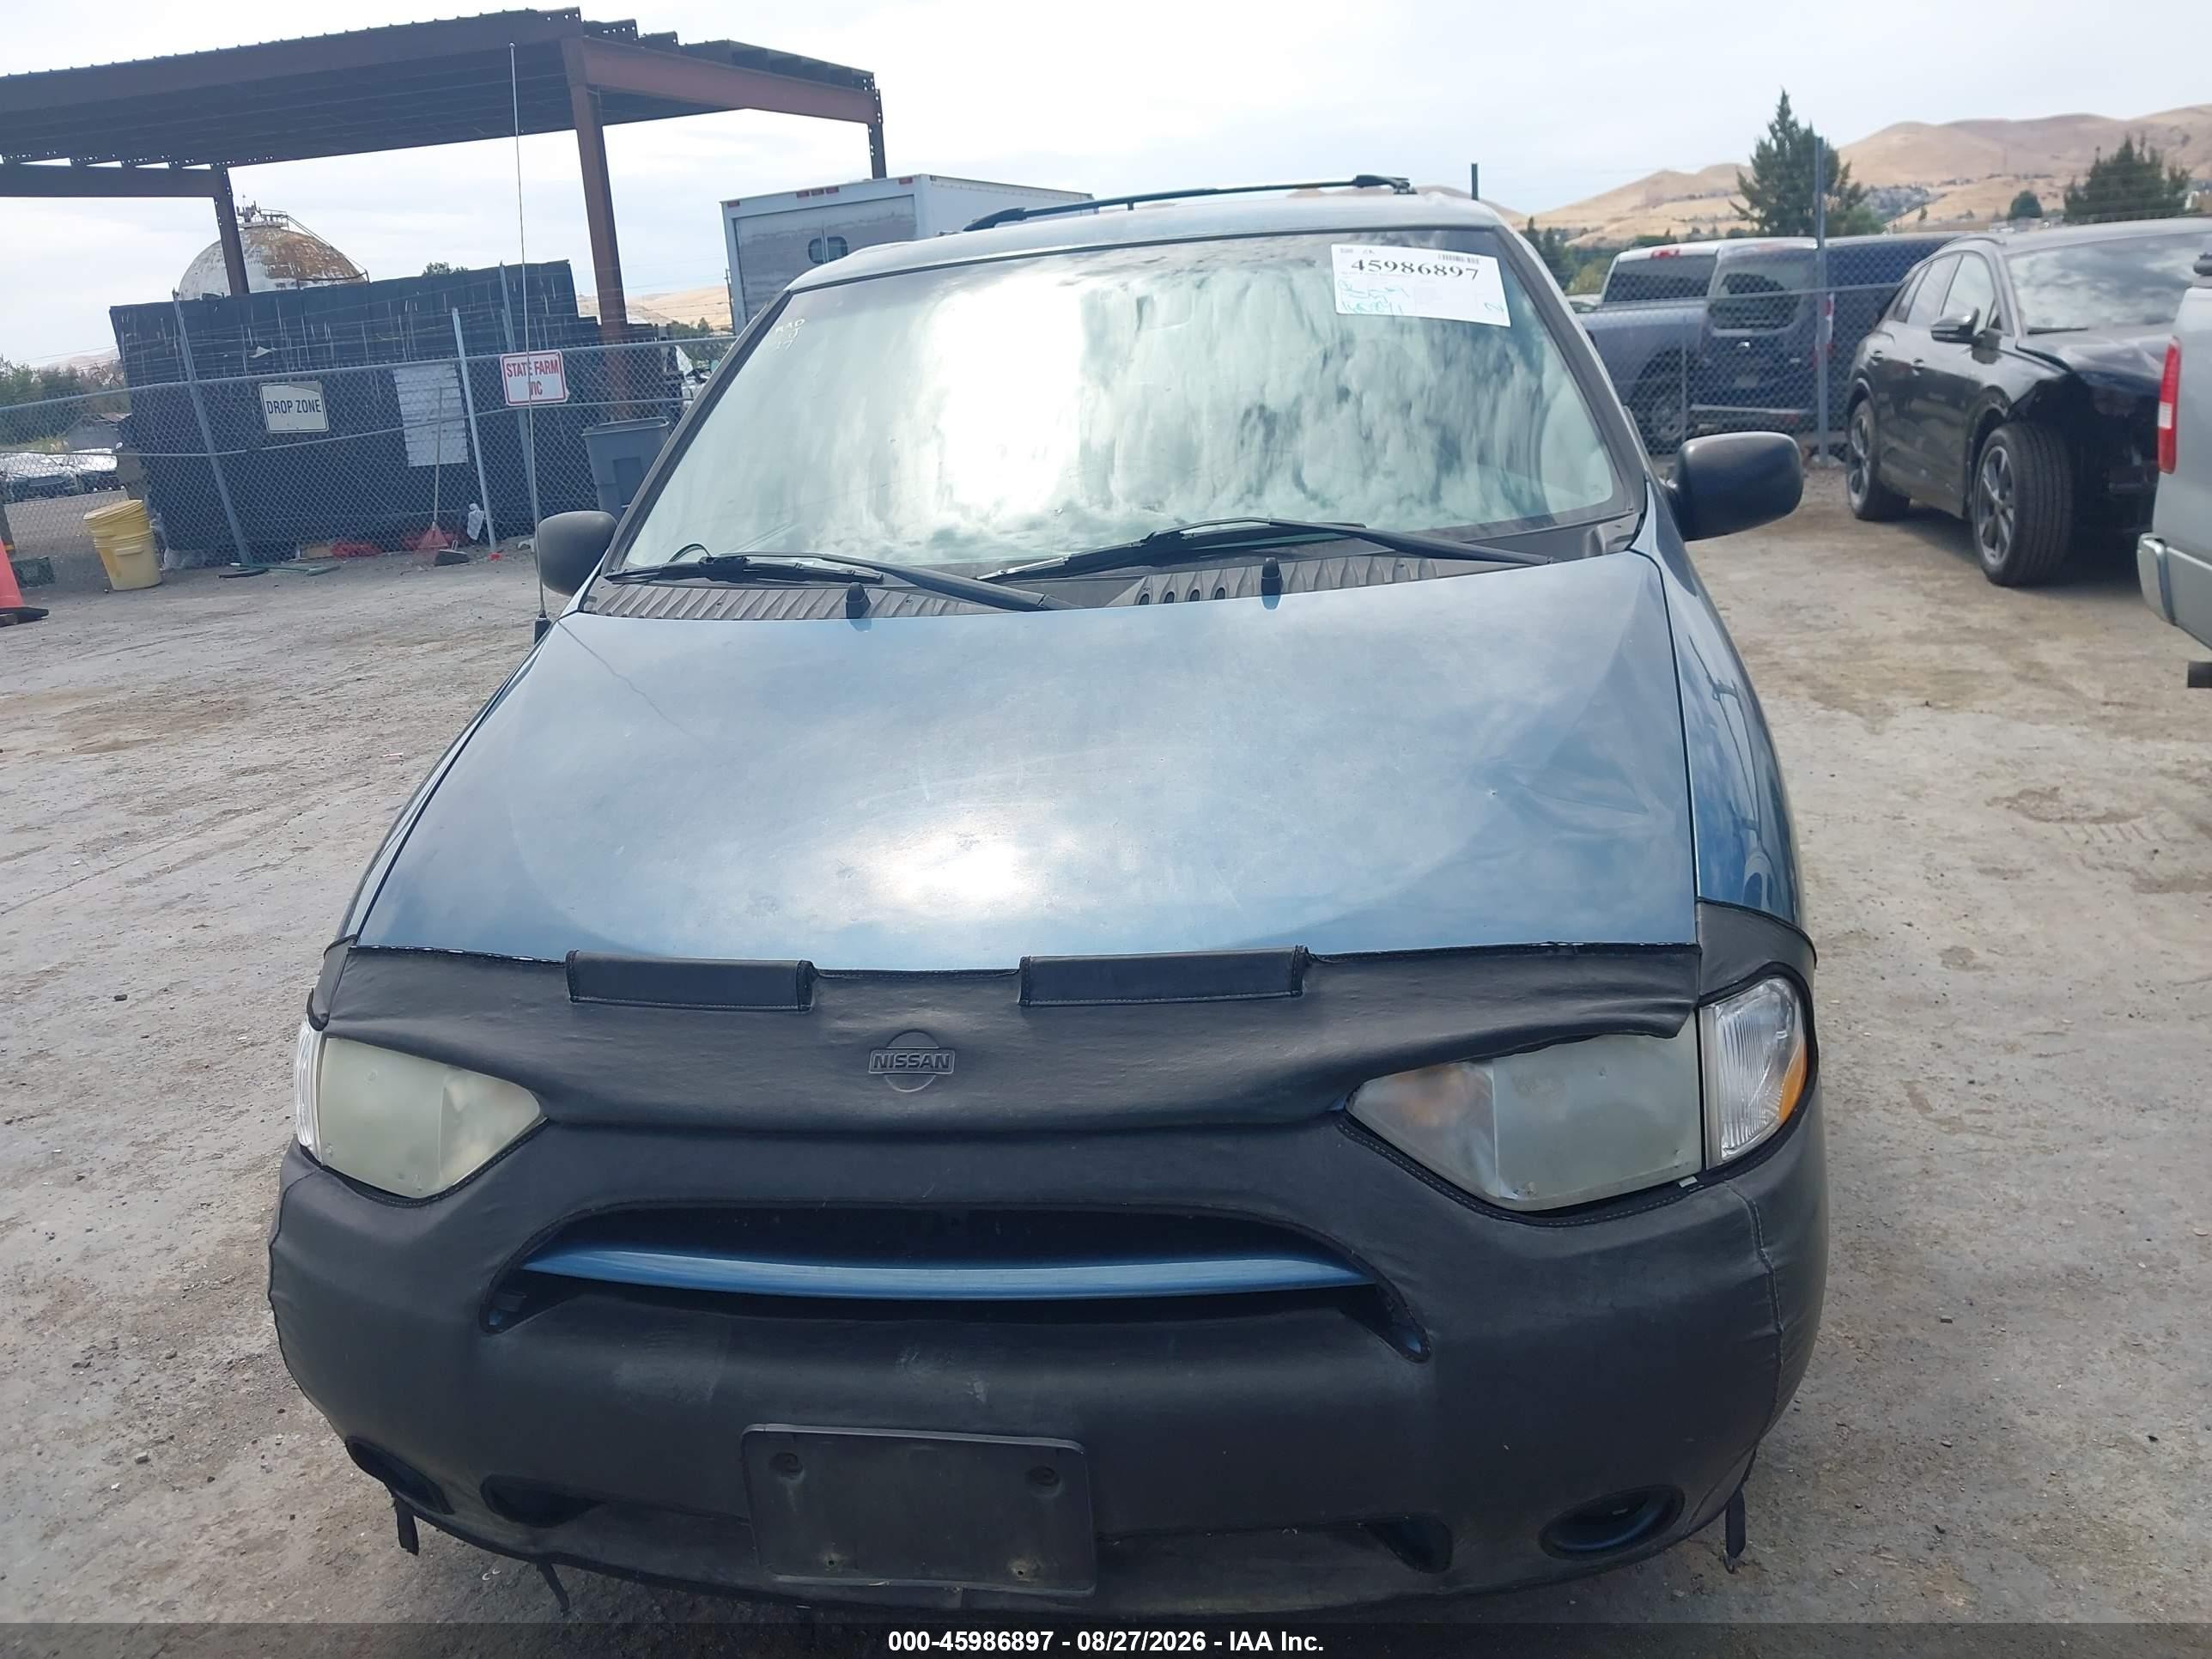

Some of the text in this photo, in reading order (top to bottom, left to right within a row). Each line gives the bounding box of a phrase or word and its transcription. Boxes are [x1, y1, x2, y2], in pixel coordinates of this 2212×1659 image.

[1351, 259, 1479, 281] 45986897
[507, 359, 560, 378] STATE FARM
[266, 399, 322, 414] DROP ZONE
[873, 1053, 951, 1069] NISSAN
